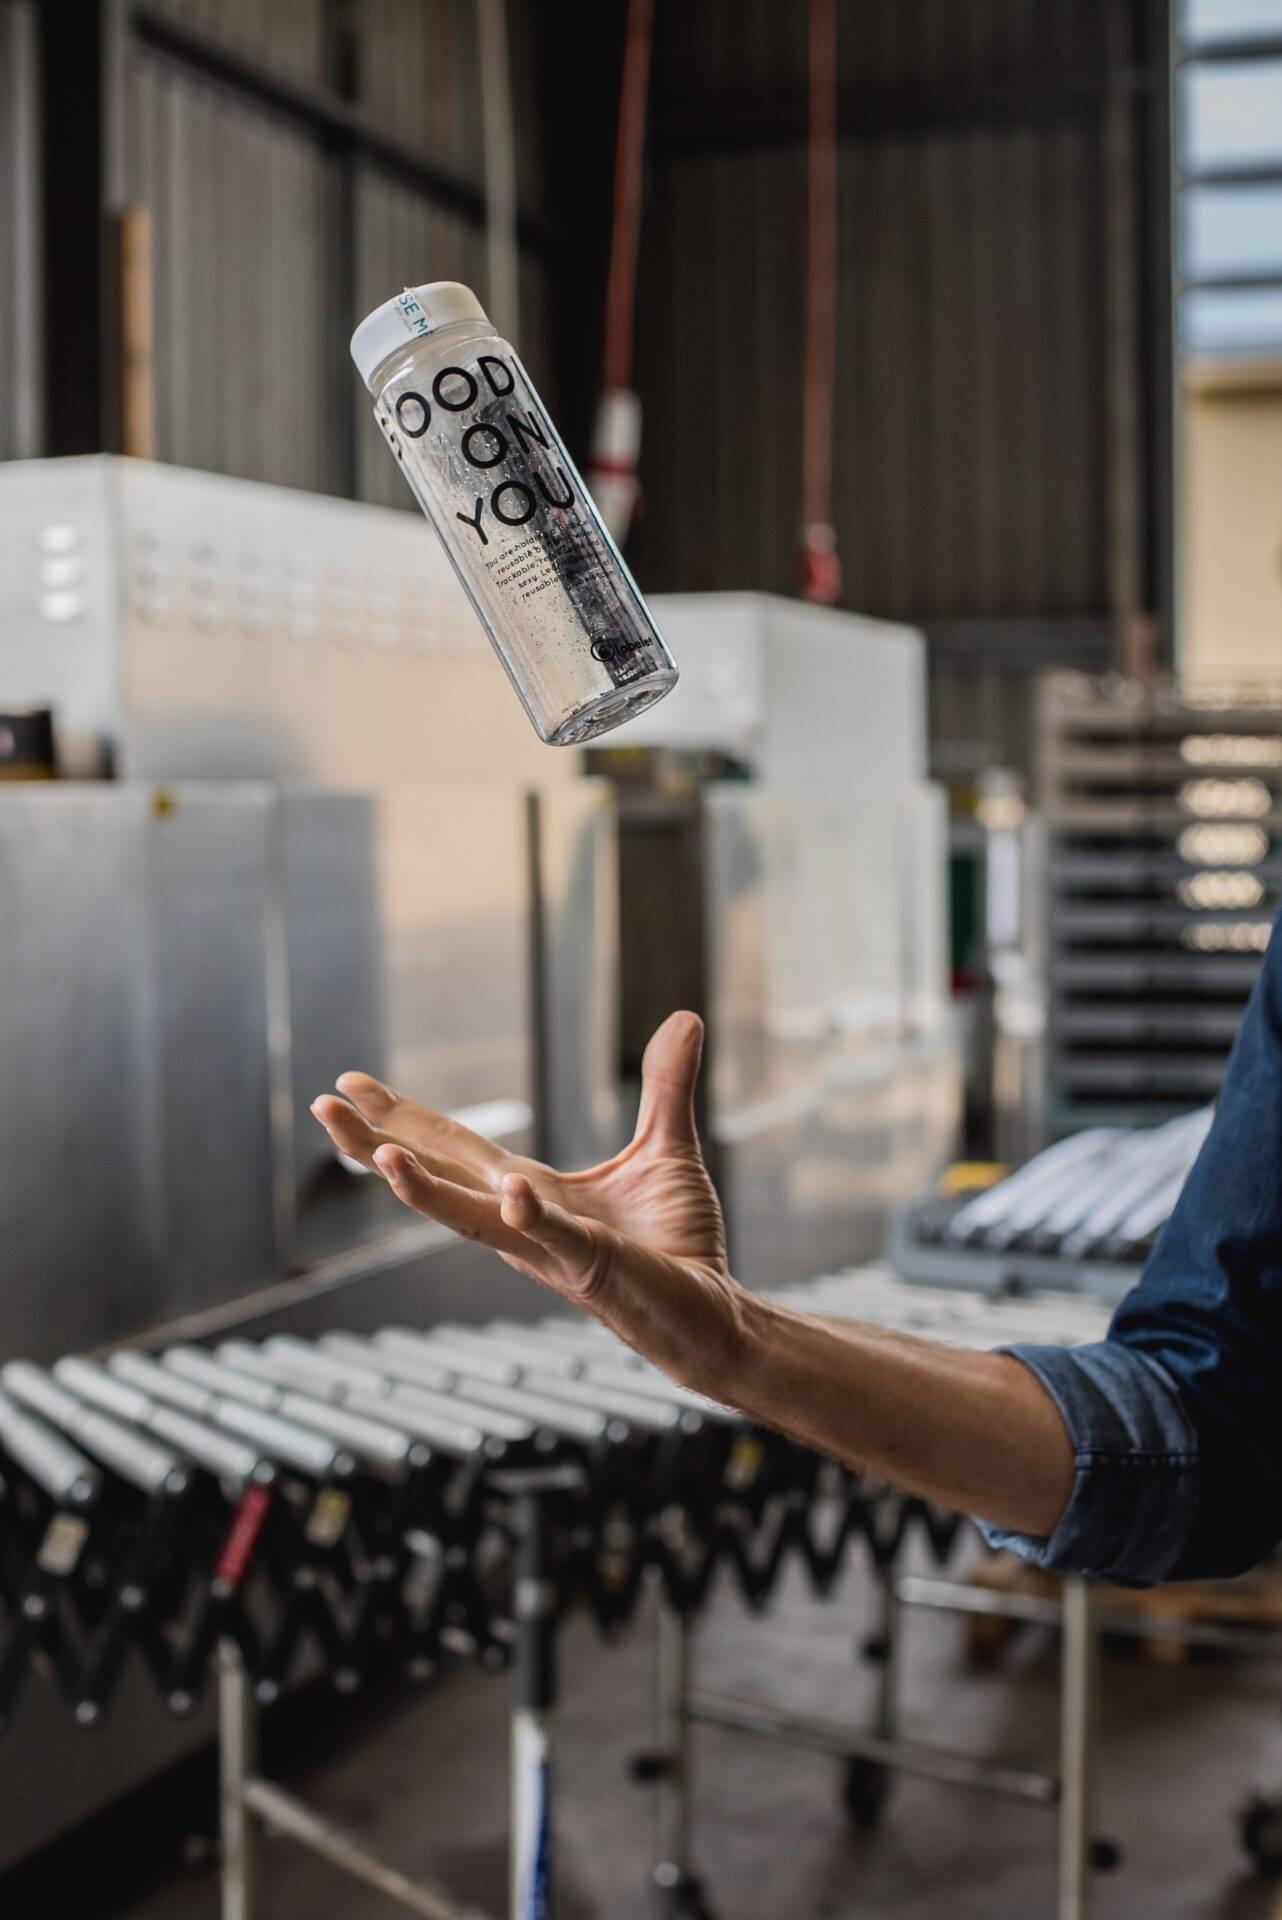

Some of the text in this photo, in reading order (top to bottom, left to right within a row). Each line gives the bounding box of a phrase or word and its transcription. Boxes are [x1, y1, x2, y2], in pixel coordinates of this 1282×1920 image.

[413, 317, 433, 338] M
[381, 356, 515, 460] OOD
[461, 411, 550, 469] ON
[456, 467, 575, 545] YOU
[484, 559, 498, 570] You
[499, 549, 513, 560] are
[497, 549, 533, 575] reusable
[496, 563, 540, 588] Trackable,
[521, 575, 561, 600] reusable
